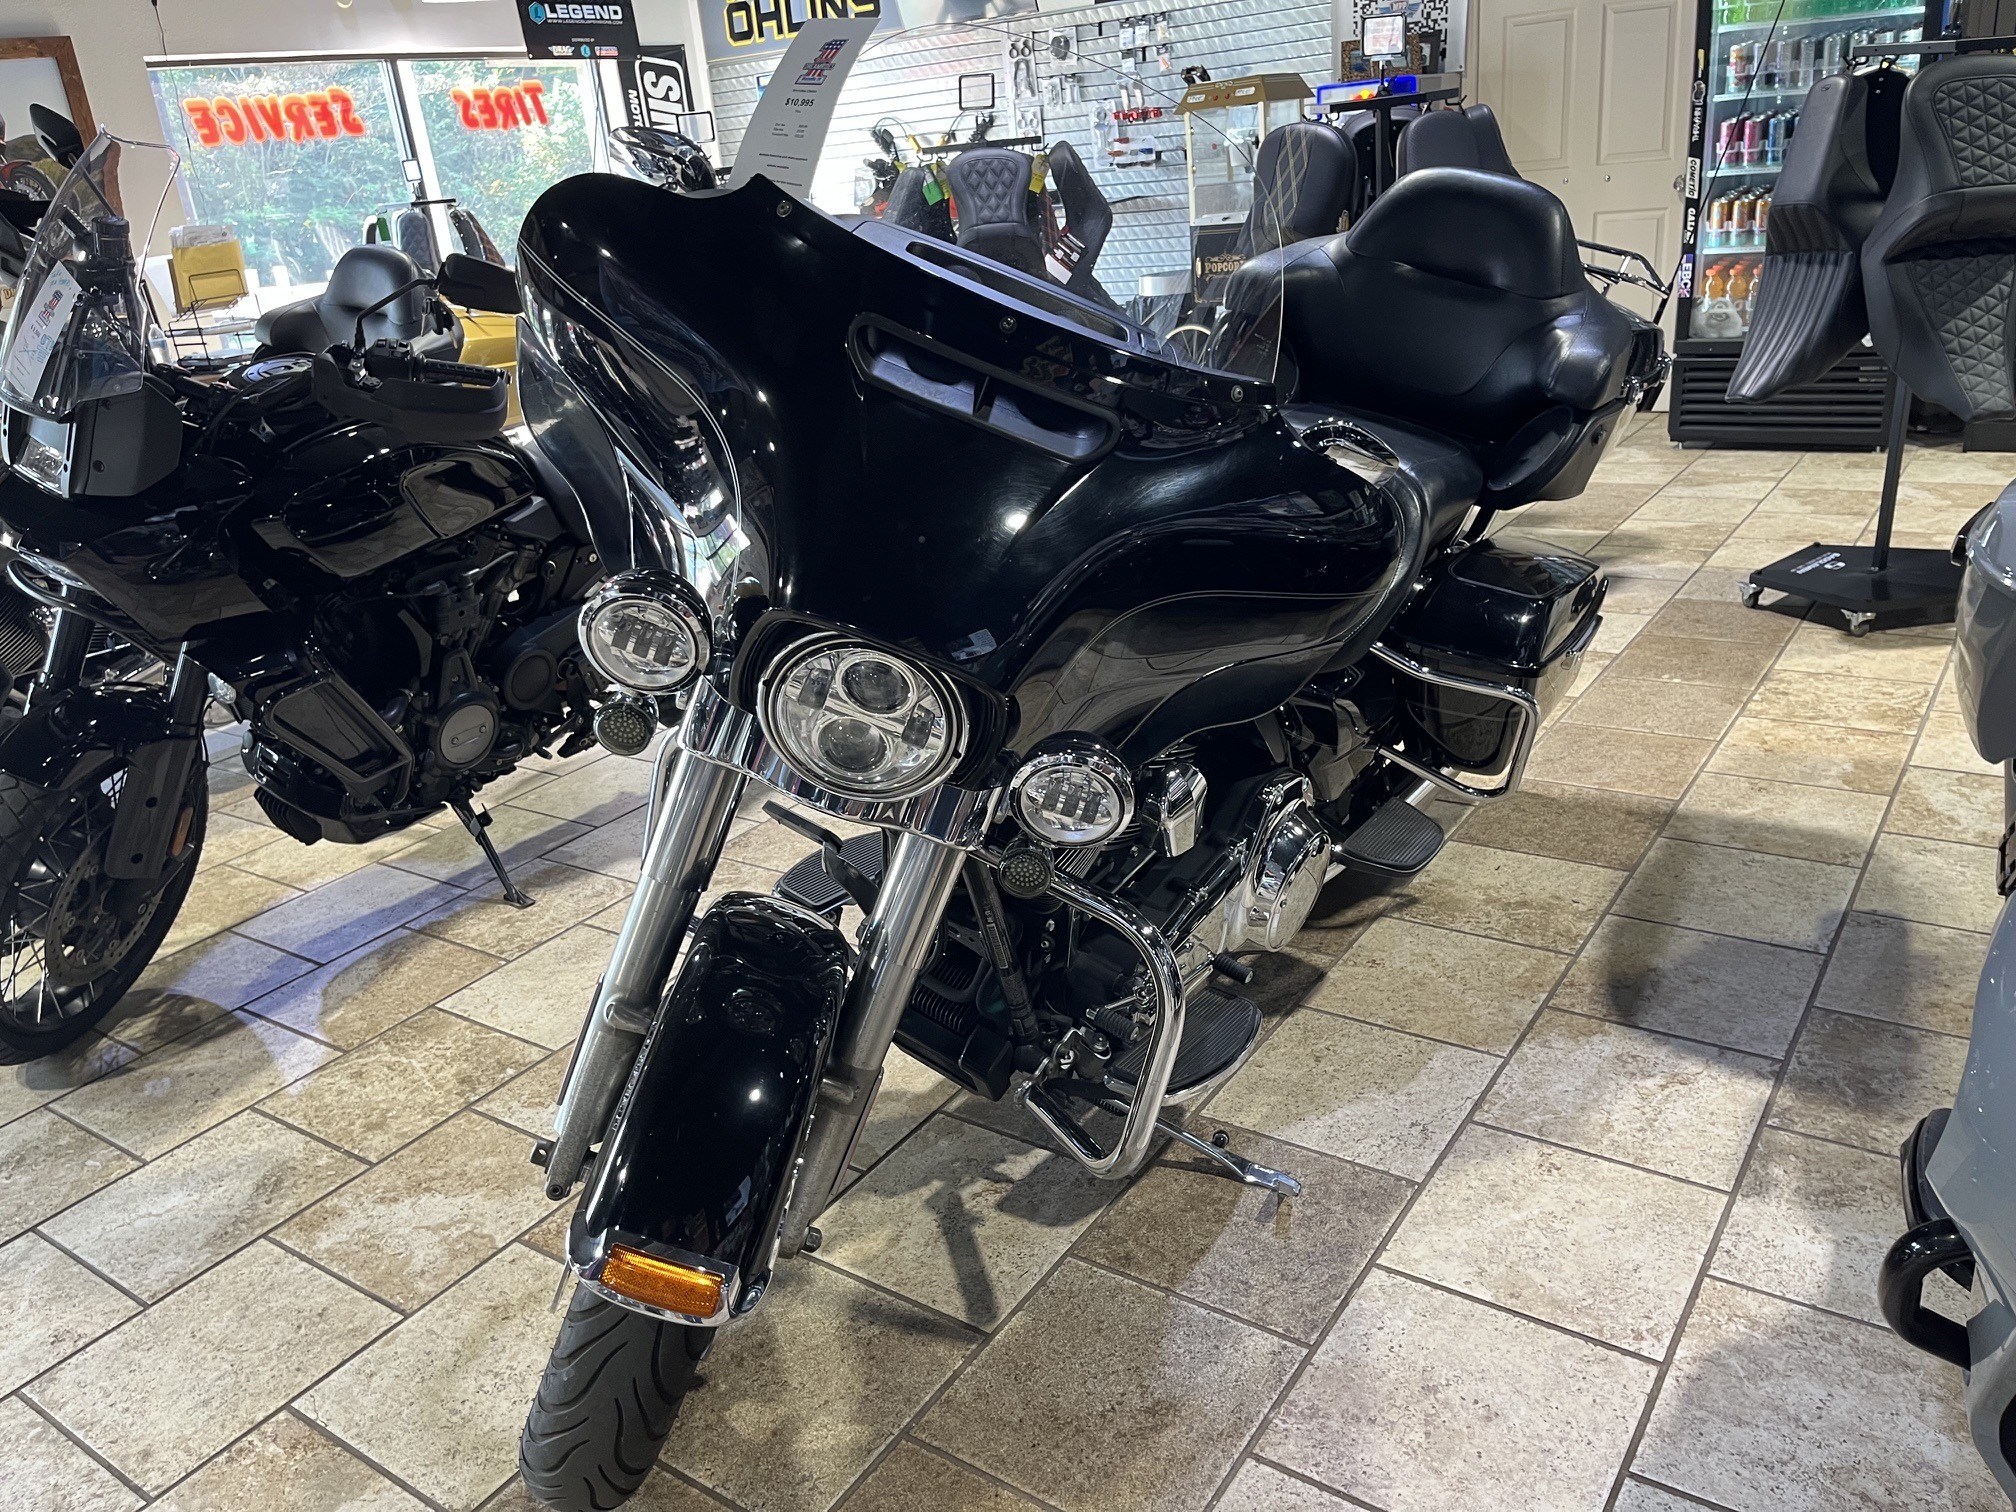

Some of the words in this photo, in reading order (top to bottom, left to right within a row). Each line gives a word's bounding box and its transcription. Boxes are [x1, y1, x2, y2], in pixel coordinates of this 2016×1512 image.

[544, 4, 623, 20] LEGEND
[785, 98, 815, 107] $10,995
[1205, 261, 1244, 273] POPCOR
[1681, 263, 1692, 289] EBC
